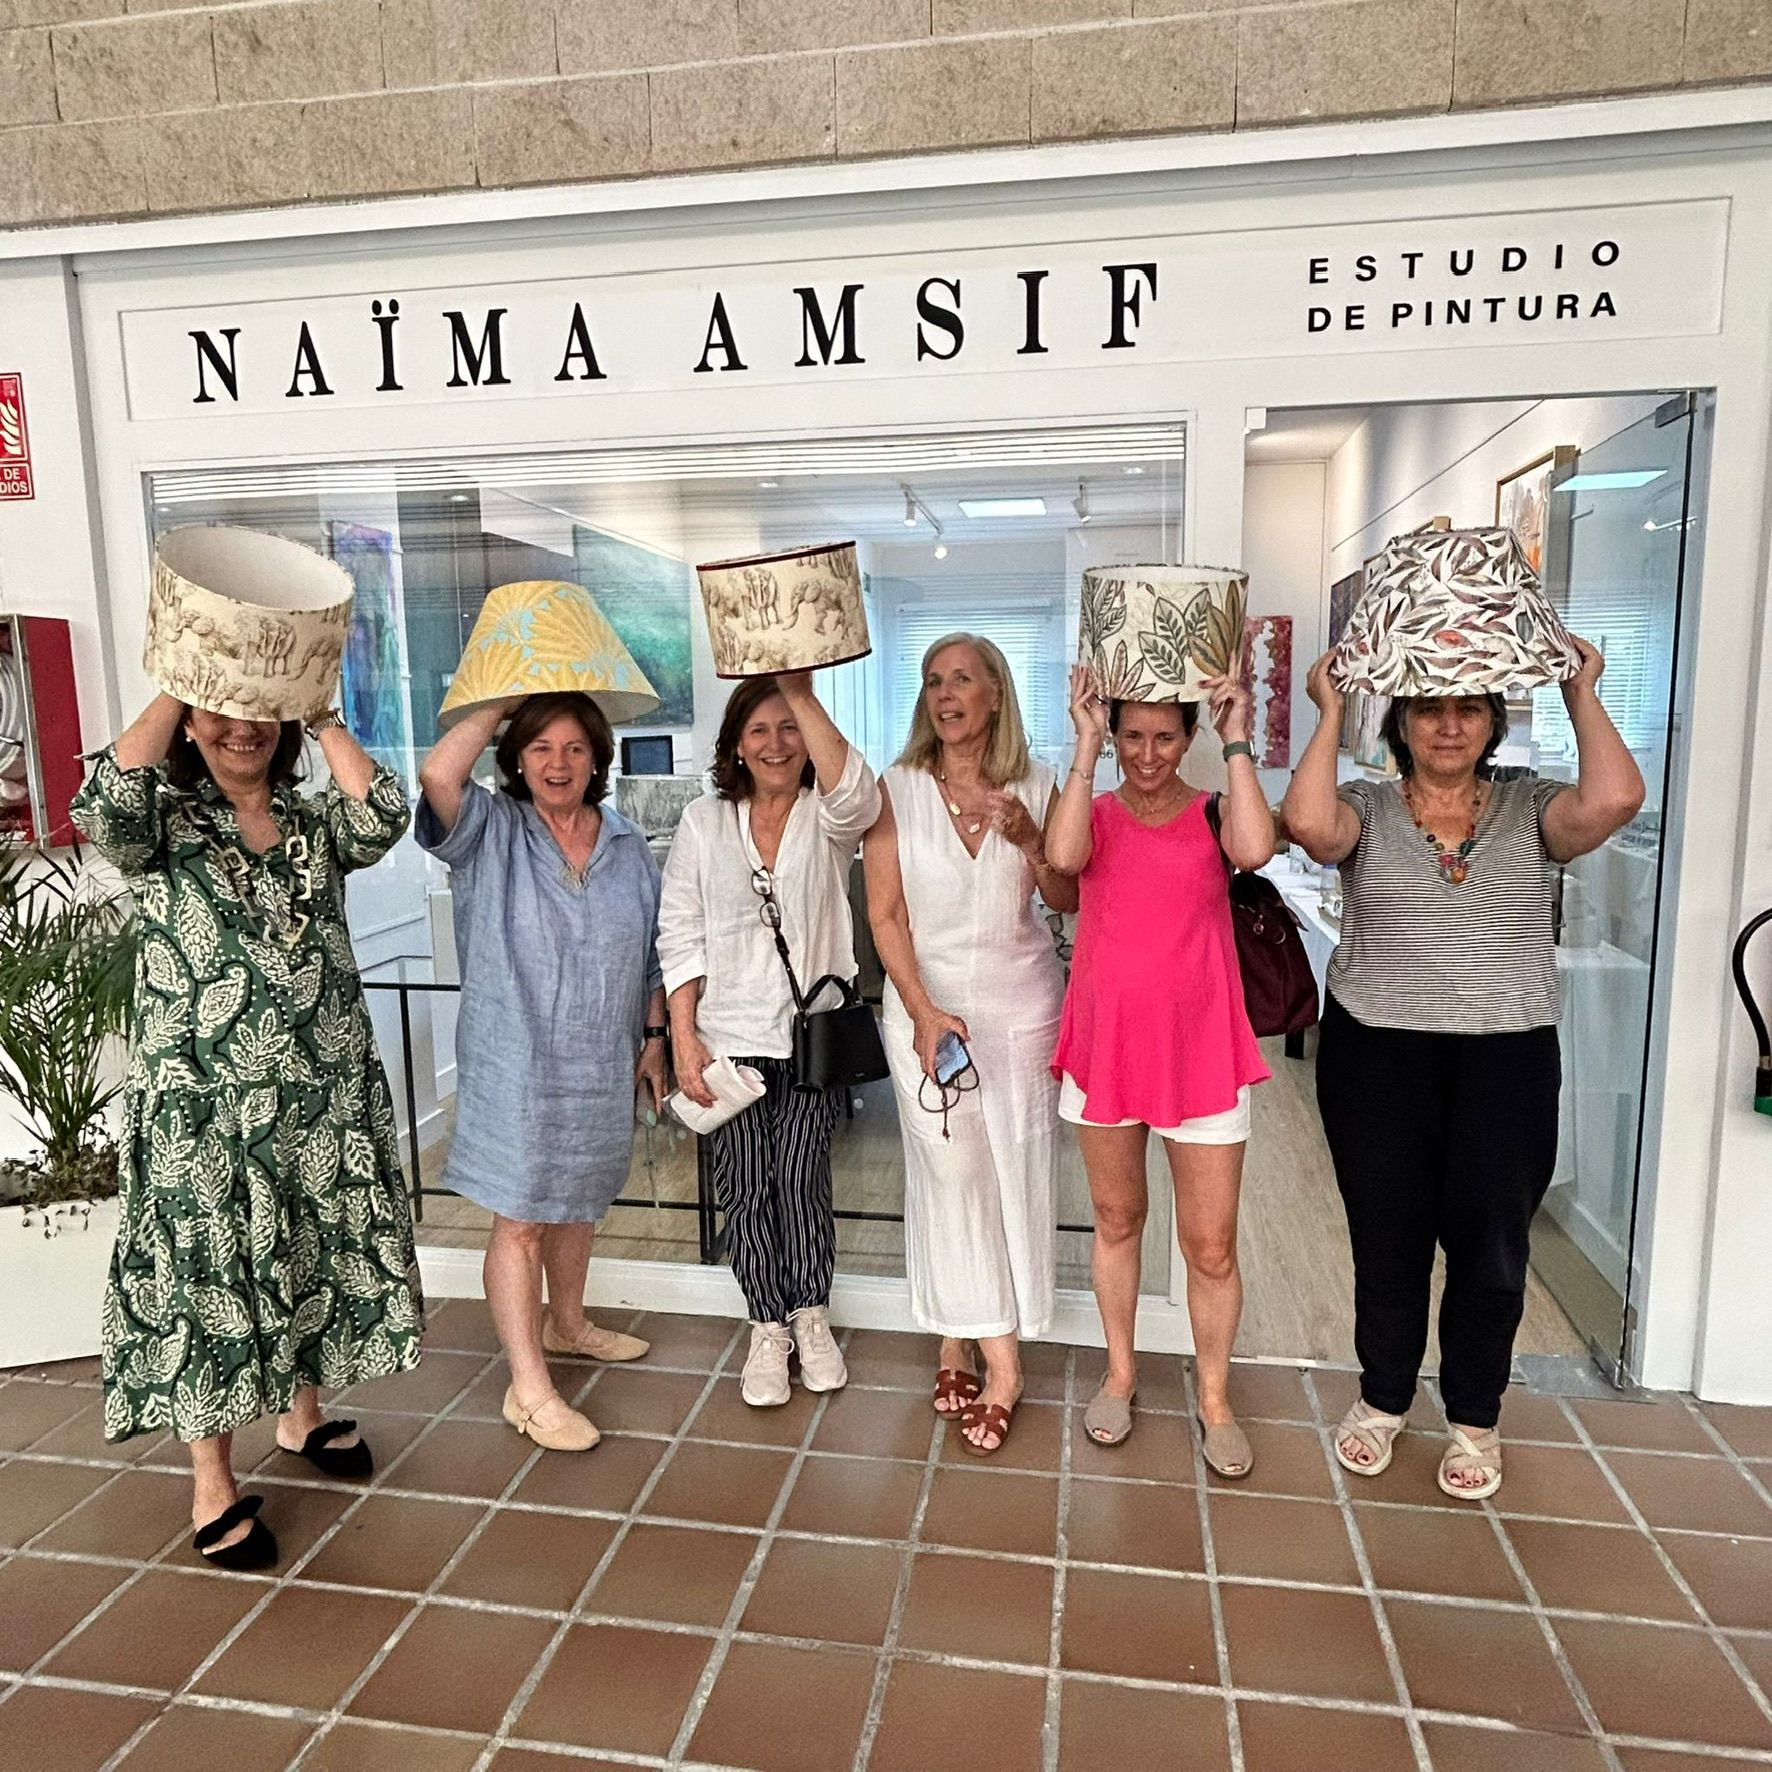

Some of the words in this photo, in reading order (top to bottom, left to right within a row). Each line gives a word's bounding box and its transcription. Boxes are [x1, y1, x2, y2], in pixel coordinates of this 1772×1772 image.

[1309, 240, 1620, 284] ESTUDIO
[188, 299, 607, 403] NAÏMA
[694, 263, 1157, 373] AMSIF
[1308, 305, 1366, 333] DE
[1391, 291, 1617, 328] PINTURA
[3, 468, 20, 480] DE
